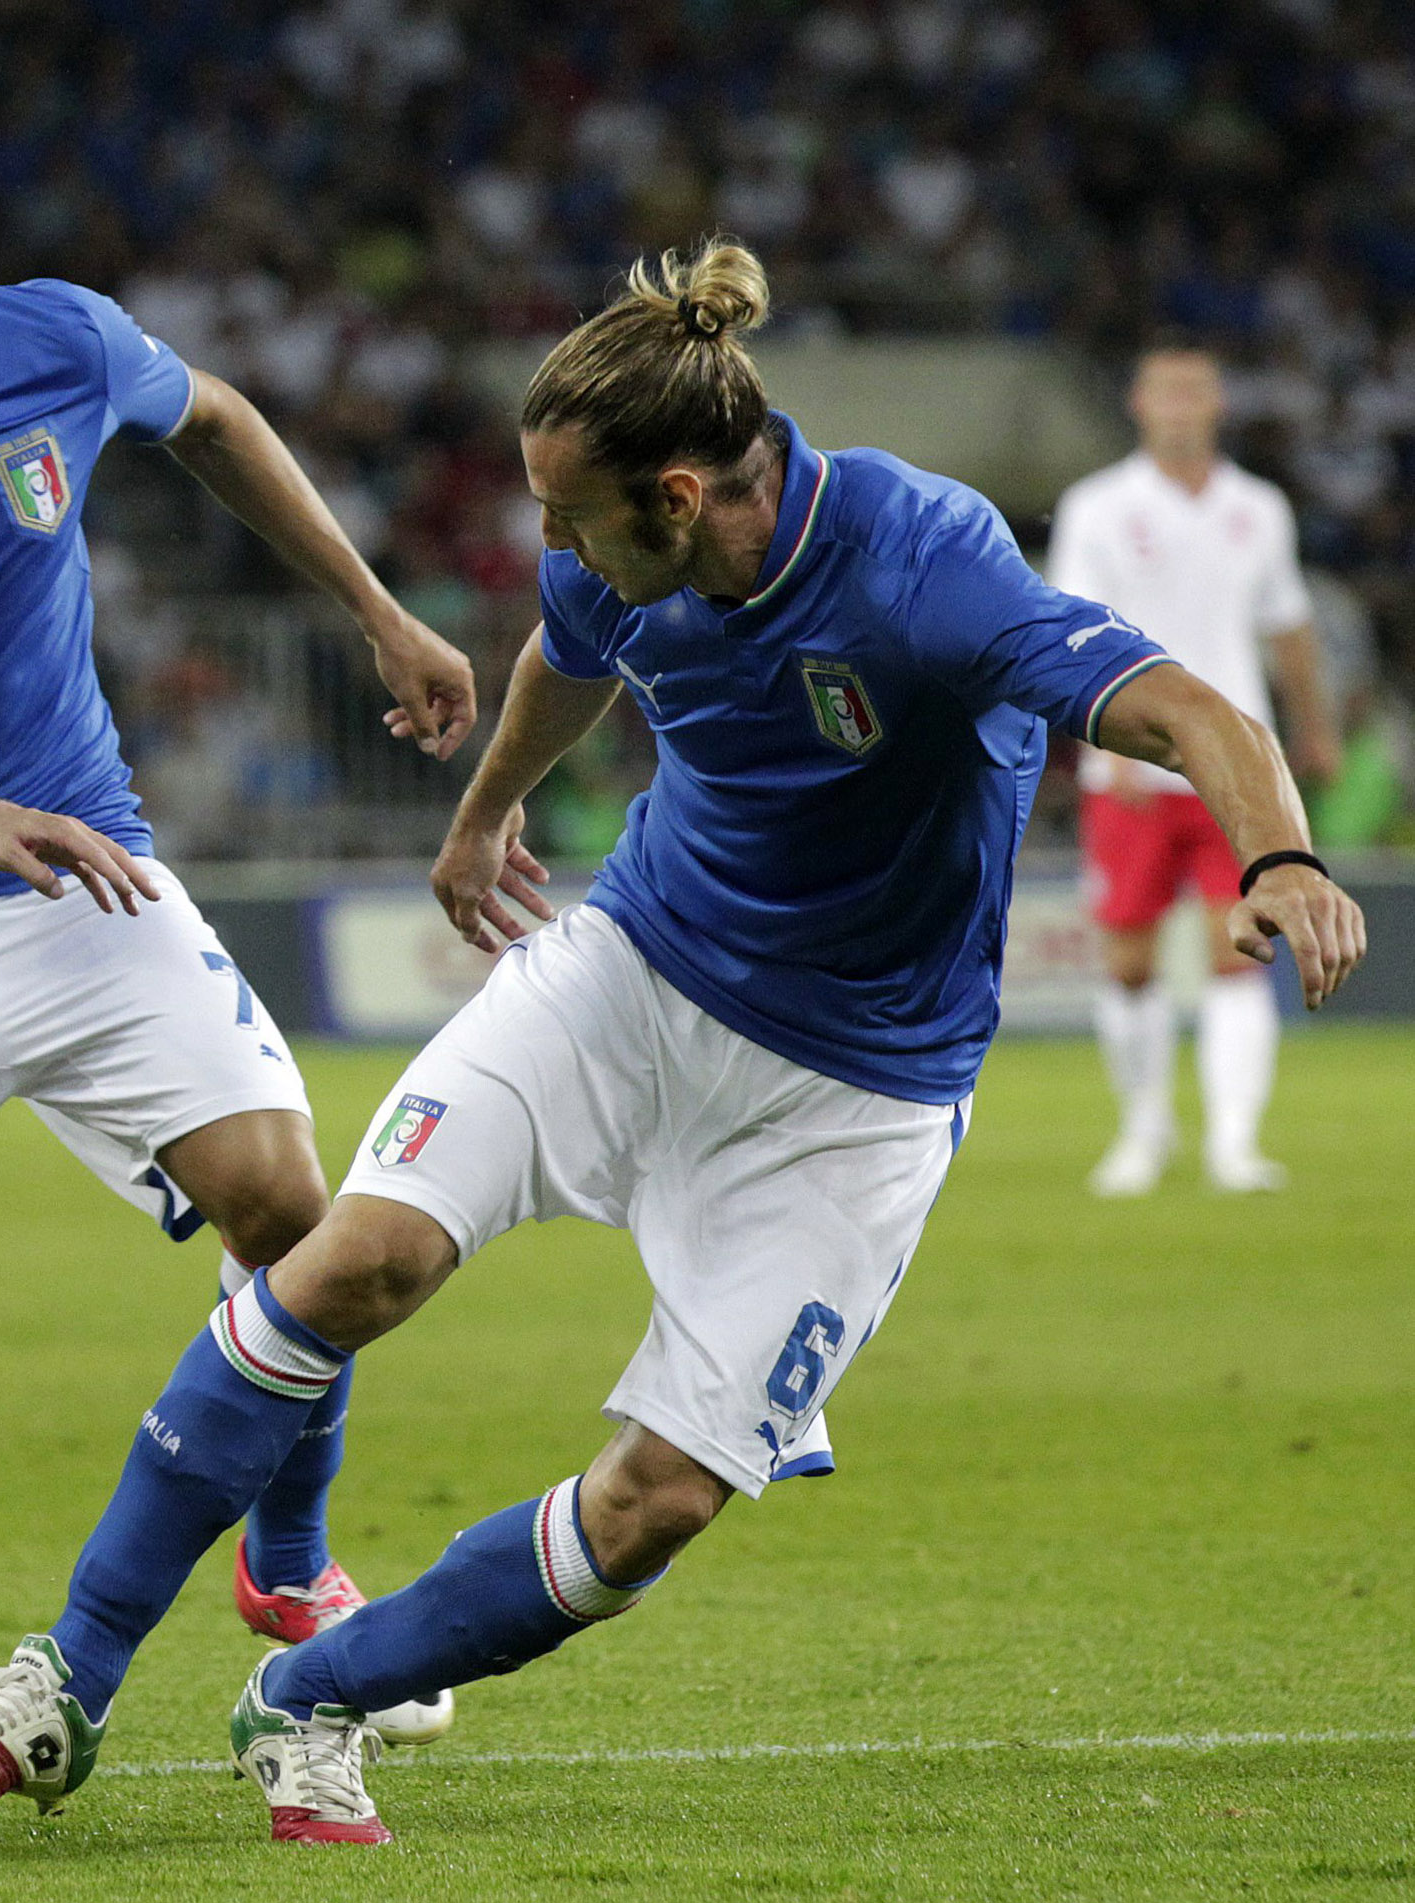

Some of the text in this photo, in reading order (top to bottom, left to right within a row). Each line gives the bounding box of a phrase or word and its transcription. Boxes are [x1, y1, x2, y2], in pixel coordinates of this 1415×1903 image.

[200, 950, 259, 1030] 7
[404, 1097, 439, 1116] ITALIA
[766, 1300, 846, 1421] 6
